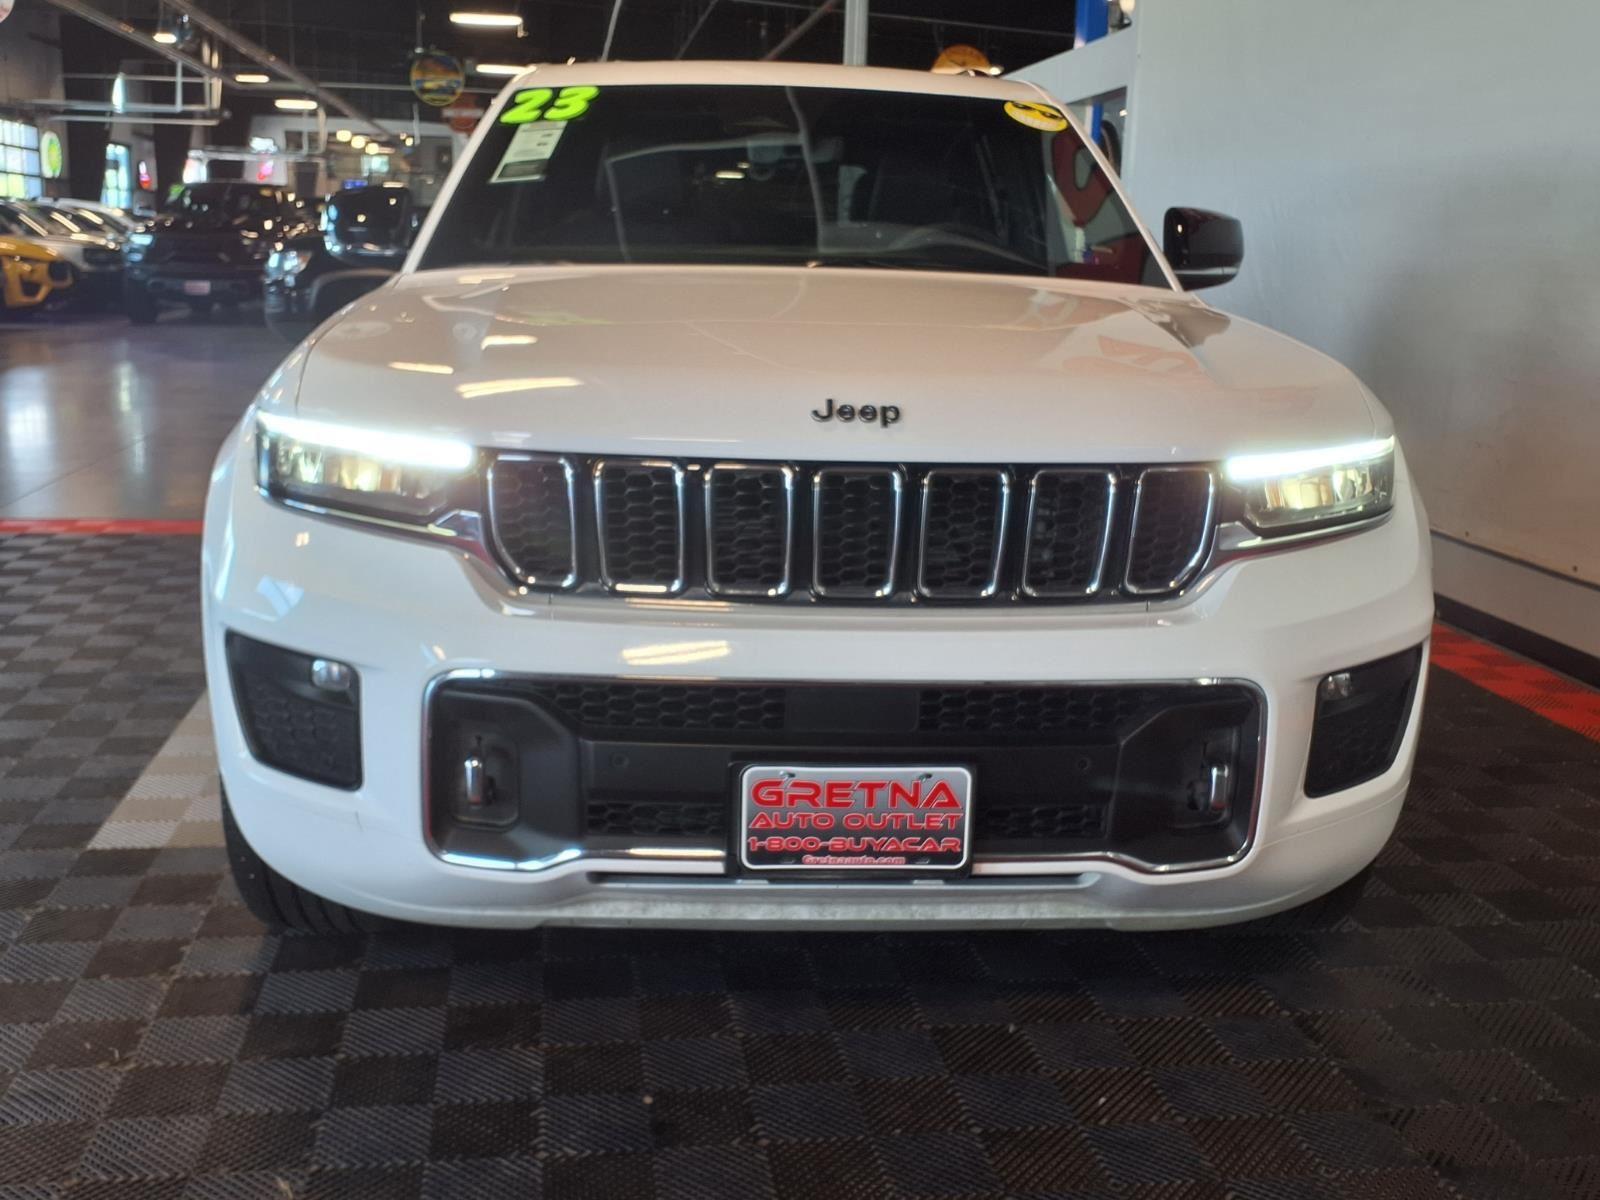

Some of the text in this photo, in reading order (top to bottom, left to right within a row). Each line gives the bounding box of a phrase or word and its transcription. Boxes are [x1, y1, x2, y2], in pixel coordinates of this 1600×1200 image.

[500, 86, 599, 124] 23
[811, 398, 901, 428] Jeep
[751, 779, 962, 809] GRETNA
[750, 812, 964, 830] AUTO OUTLET
[748, 836, 962, 853] 1-800-BUYACAR
